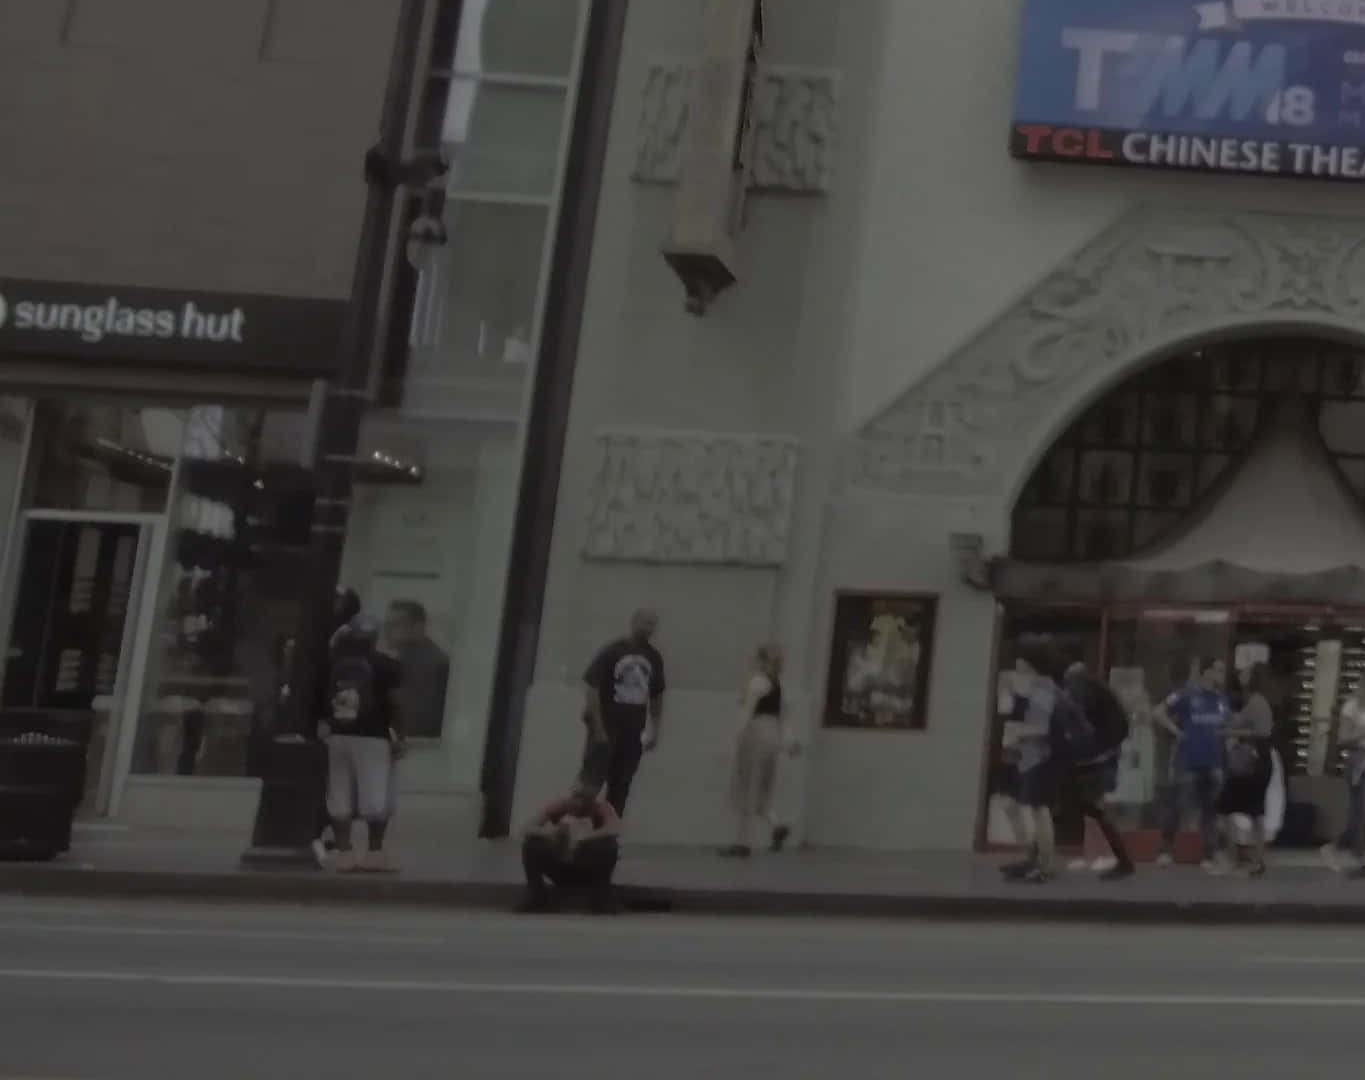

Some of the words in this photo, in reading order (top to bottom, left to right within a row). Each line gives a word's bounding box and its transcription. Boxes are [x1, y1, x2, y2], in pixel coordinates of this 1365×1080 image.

[1018, 125, 1112, 158] TCL
[1122, 132, 1280, 172] CHINESE
[14, 296, 175, 344] sunglass
[180, 301, 245, 344] hut
